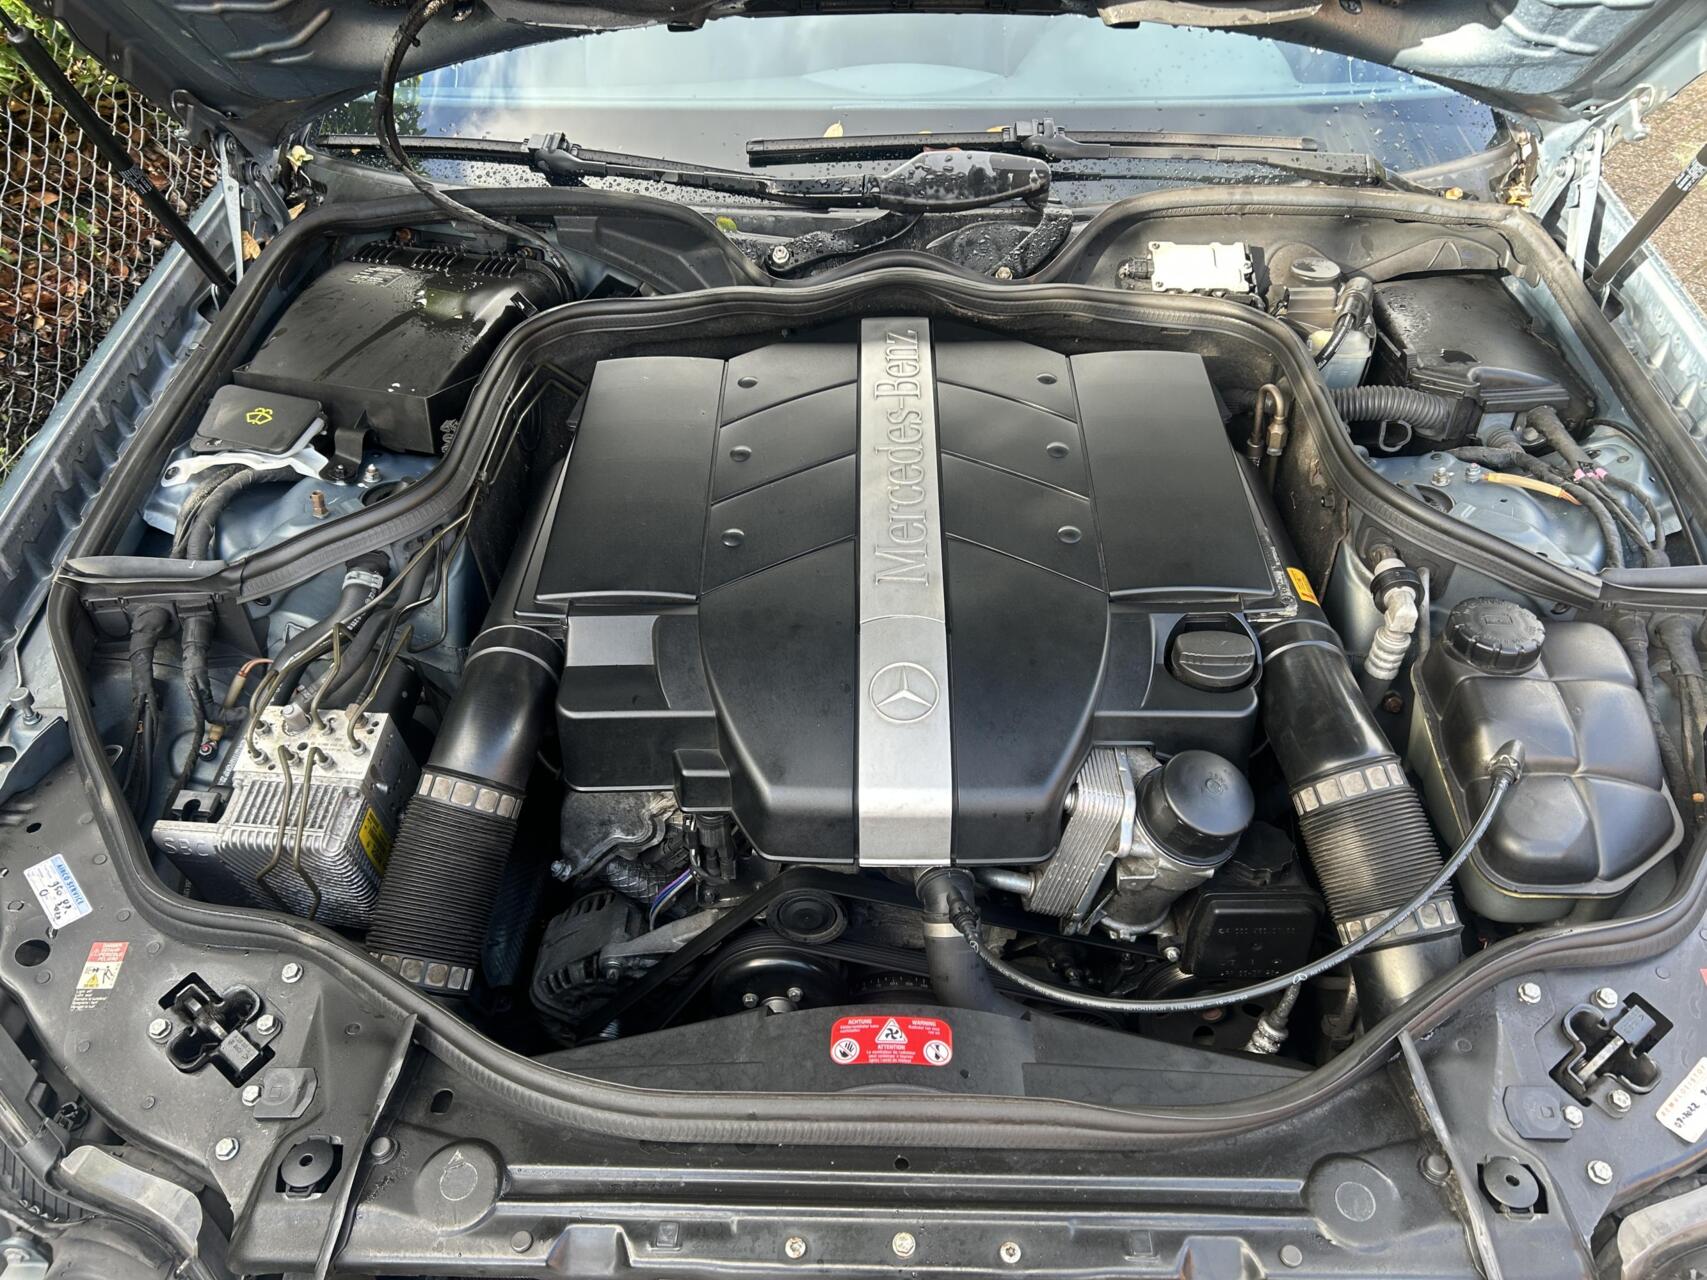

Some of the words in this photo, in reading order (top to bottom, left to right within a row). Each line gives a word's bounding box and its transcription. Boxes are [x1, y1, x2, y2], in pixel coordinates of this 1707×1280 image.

[874, 329, 929, 586] Mercedes-Benz
[164, 837, 209, 856] SBC
[57, 864, 70, 881] AIRCO
[66, 881, 84, 905] SERVICE
[848, 1018, 872, 1026] ACHTUNG
[912, 1019, 937, 1028] WARNING
